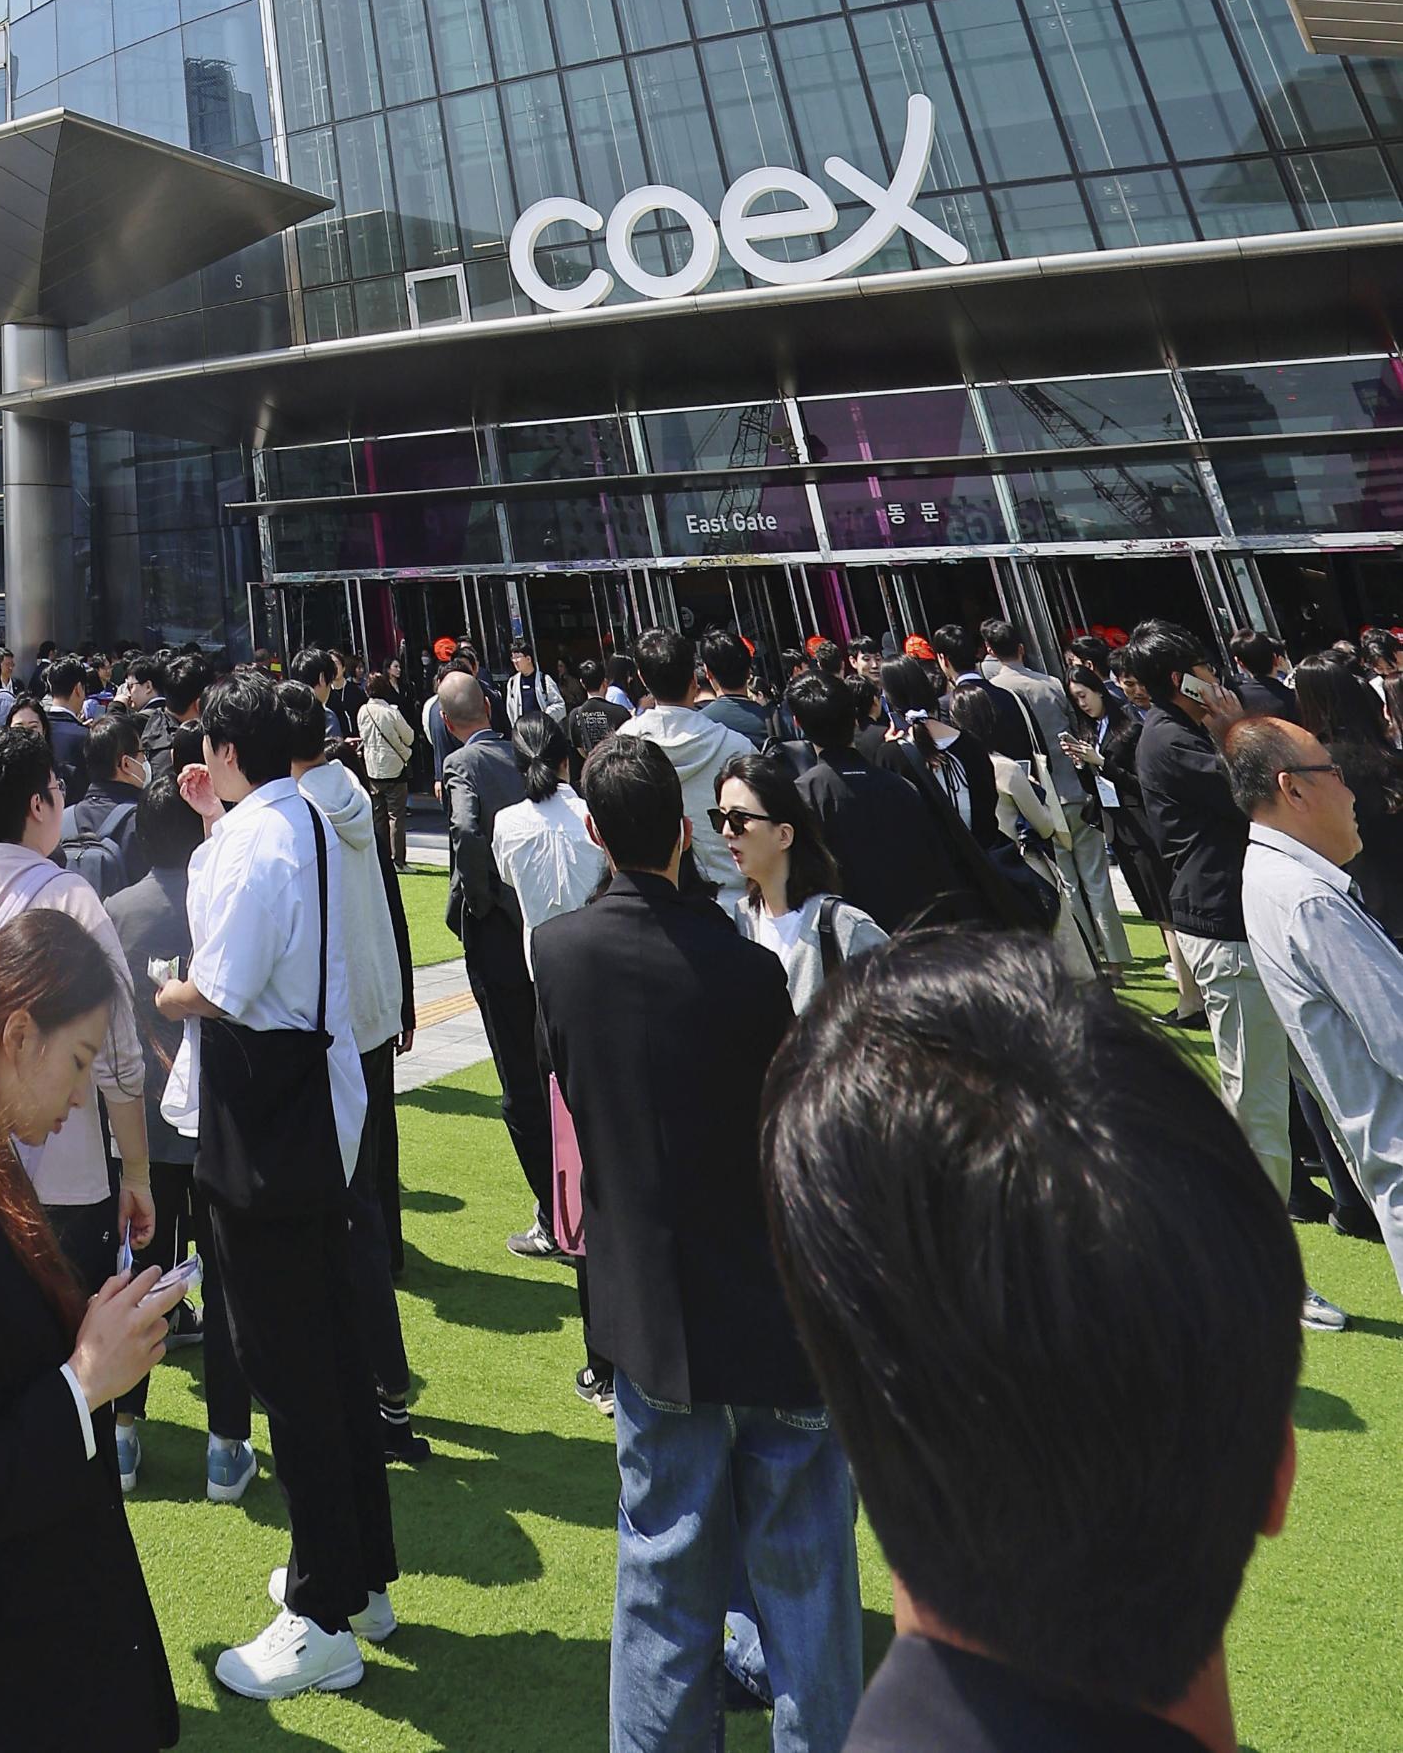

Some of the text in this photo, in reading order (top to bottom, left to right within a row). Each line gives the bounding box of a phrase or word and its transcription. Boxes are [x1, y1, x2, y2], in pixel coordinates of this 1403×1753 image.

[509, 93, 969, 312] coex
[235, 274, 243, 289] S
[685, 512, 778, 534] East Gate
